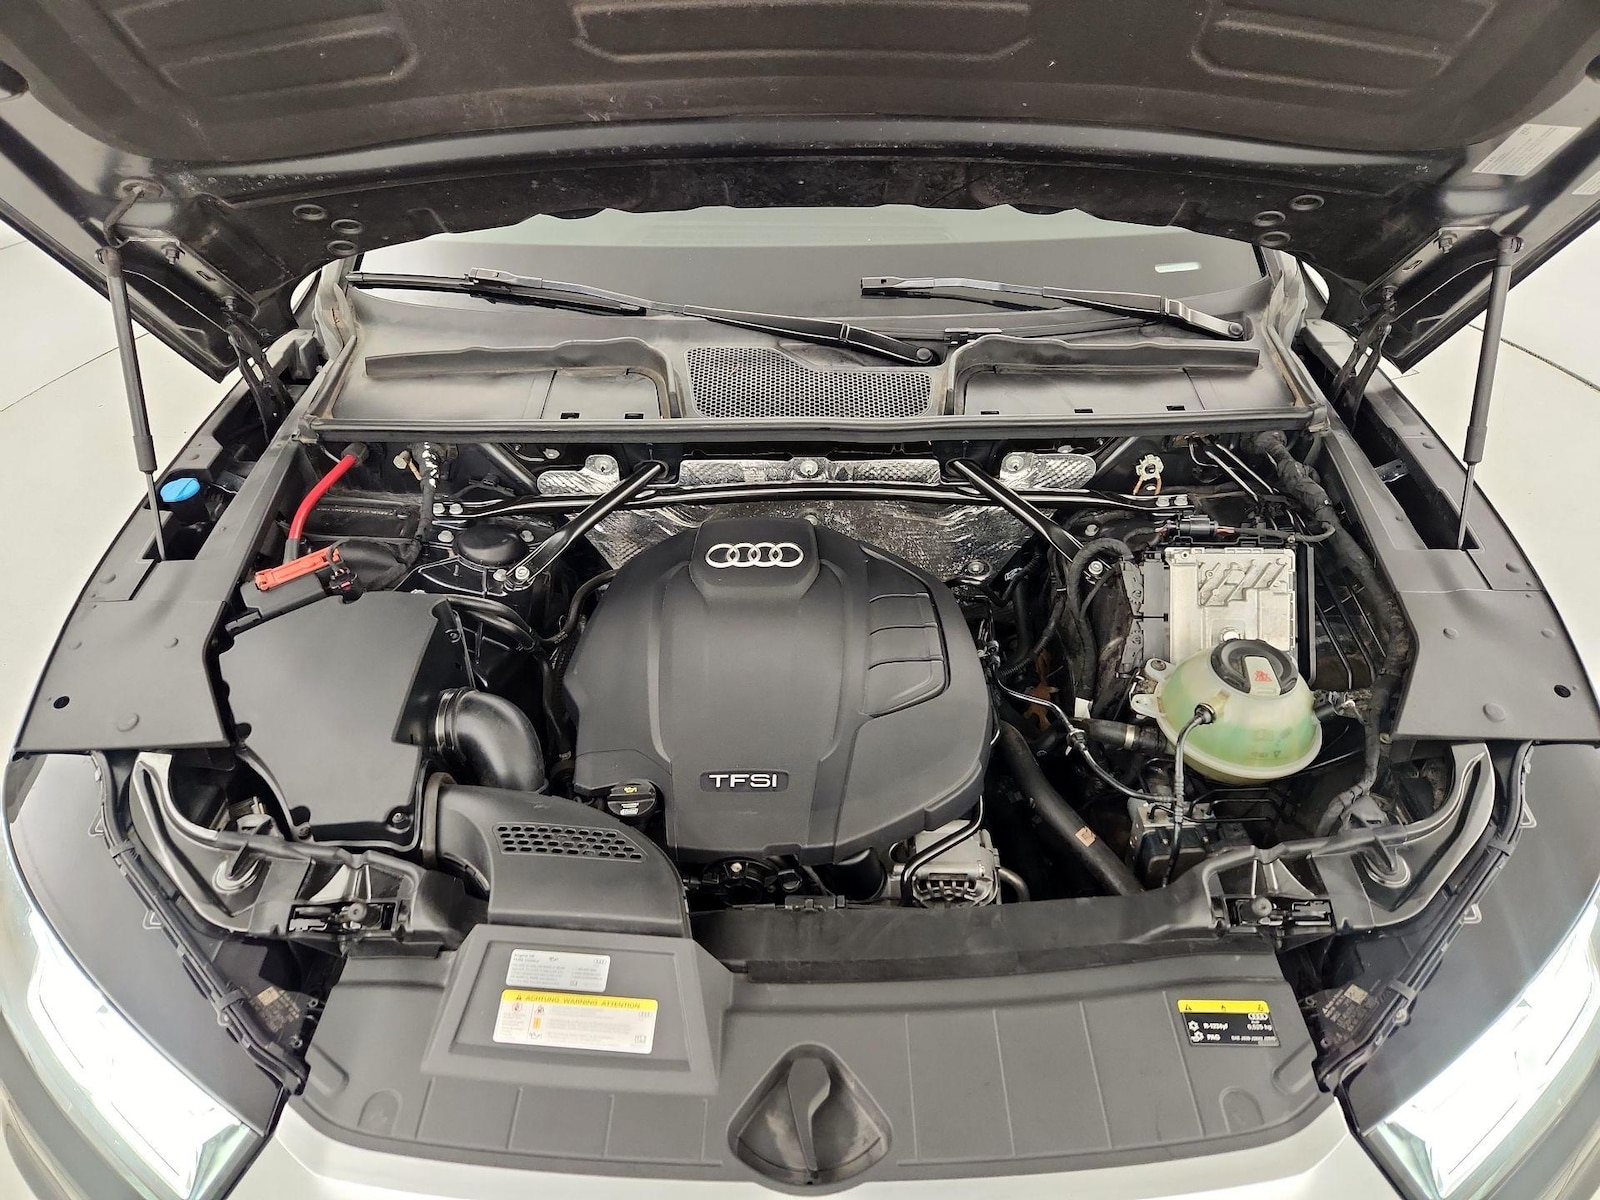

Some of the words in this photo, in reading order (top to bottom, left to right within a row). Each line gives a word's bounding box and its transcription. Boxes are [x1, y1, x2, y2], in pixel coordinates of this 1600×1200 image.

[708, 773, 778, 788] TFSI
[525, 995, 559, 1004] ACHTUNG
[563, 998, 598, 1006] WARNING
[601, 1001, 641, 1009] ATTENTION
